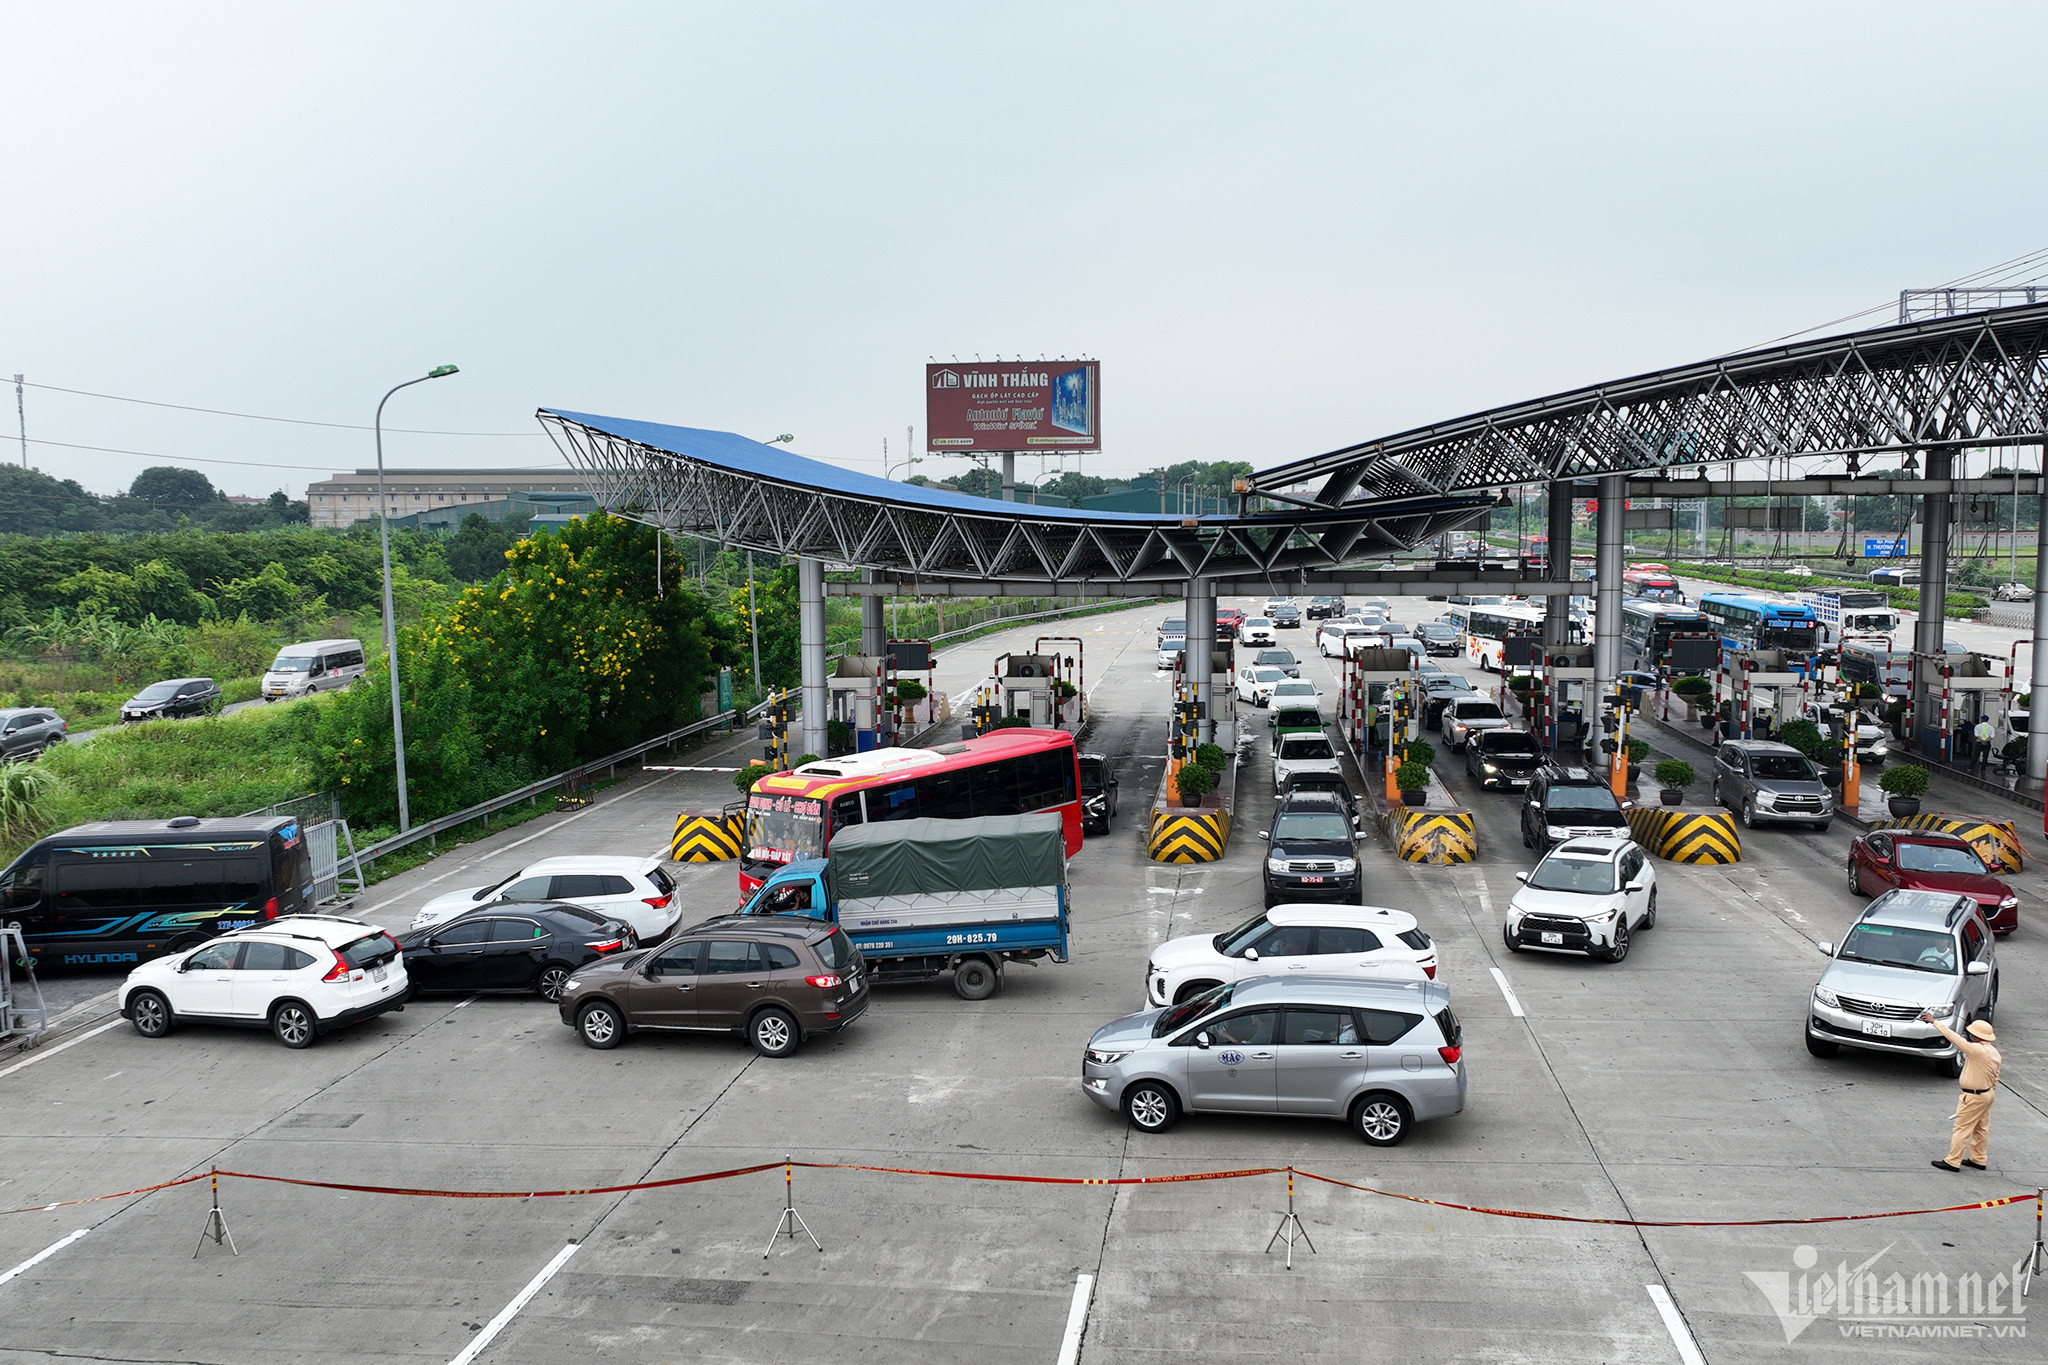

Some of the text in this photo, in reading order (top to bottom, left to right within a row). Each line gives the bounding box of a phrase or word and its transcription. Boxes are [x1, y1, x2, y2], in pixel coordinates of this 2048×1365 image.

[963, 366, 1049, 388] VĨNH THẮNG
[947, 933, 998, 944] 29H-825.79
[64, 952, 138, 964] HYUNDAI
[1222, 1053, 1241, 1063] MAC
